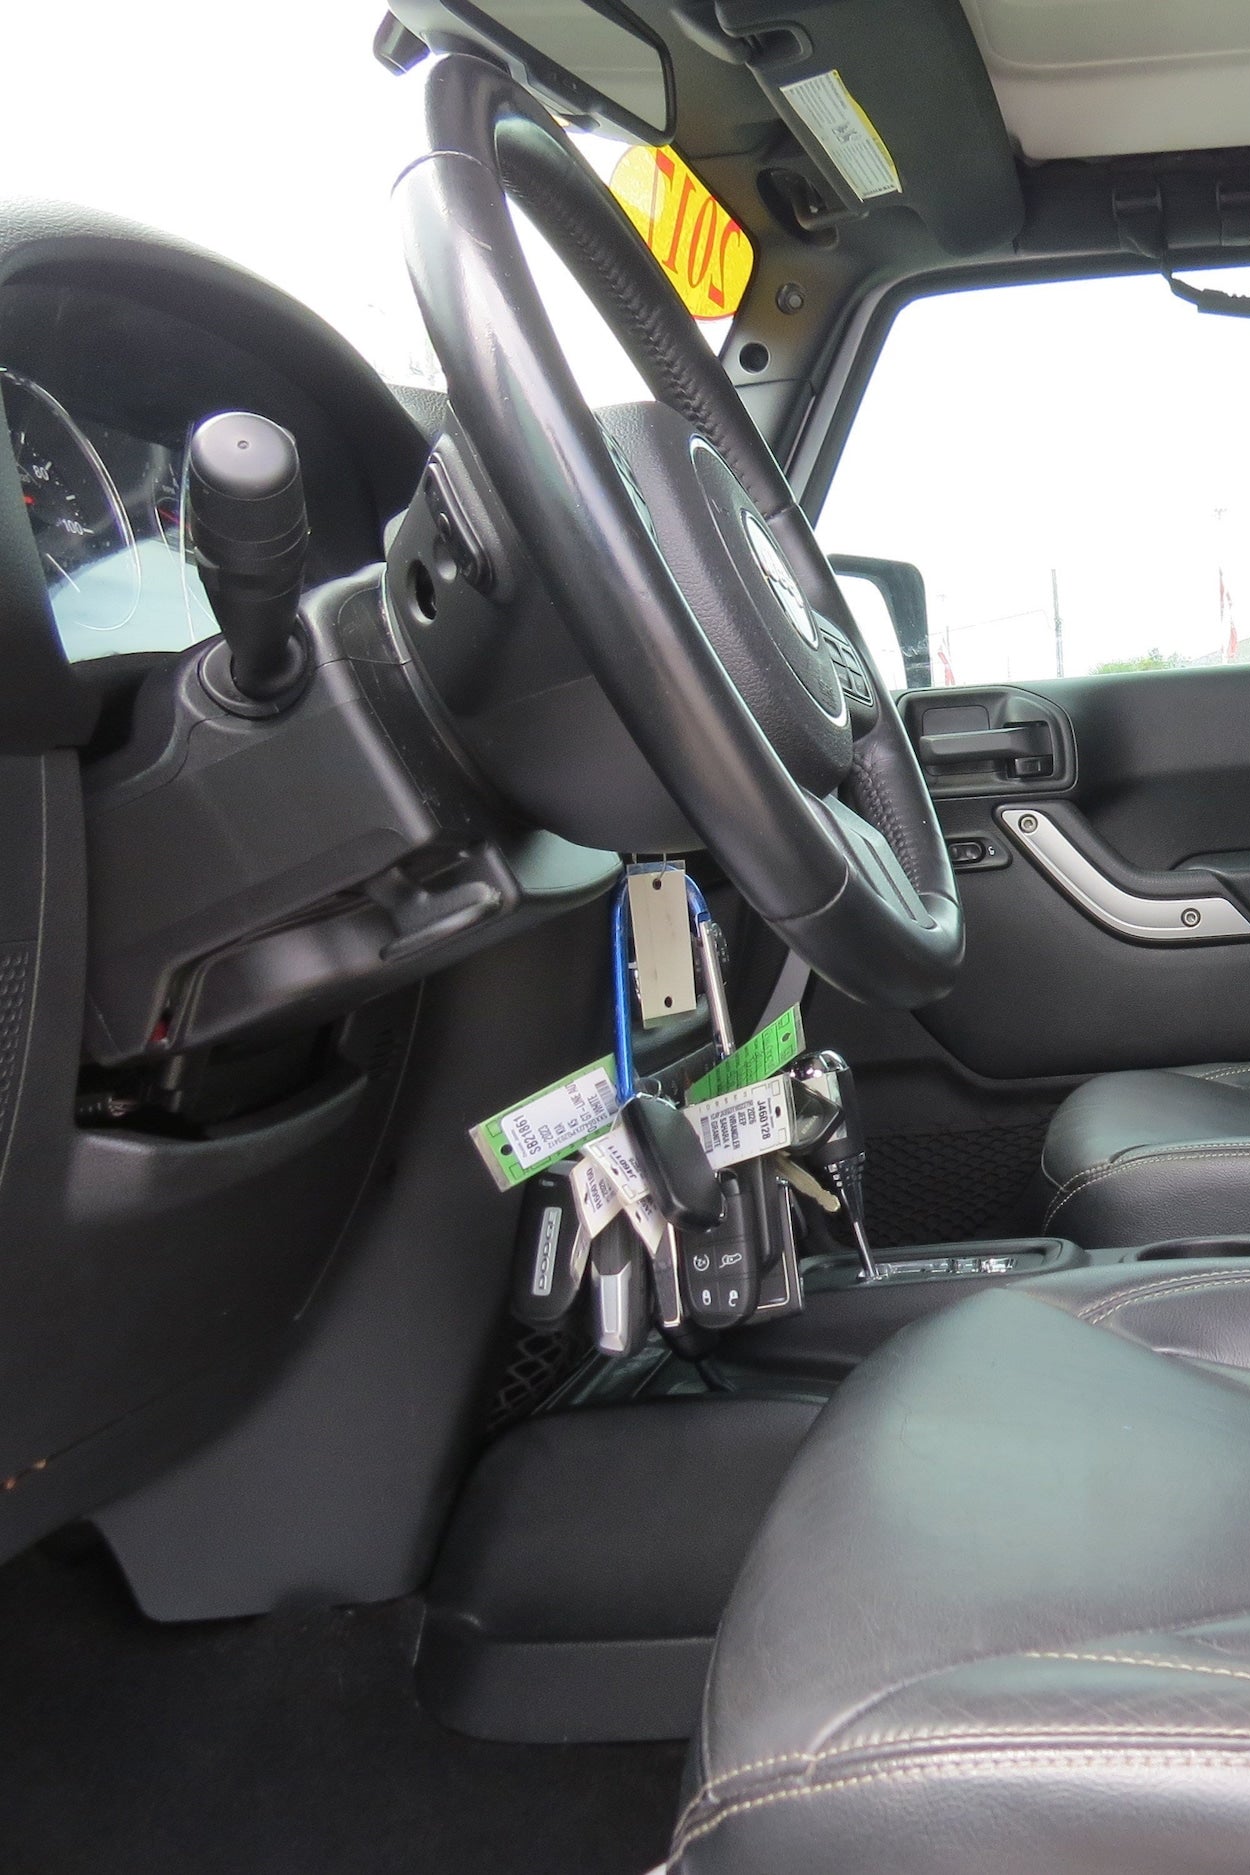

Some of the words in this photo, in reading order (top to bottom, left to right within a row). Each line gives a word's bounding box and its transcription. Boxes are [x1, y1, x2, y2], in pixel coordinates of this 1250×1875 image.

[32, 463, 50, 481] 80
[61, 519, 83, 535] 100
[587, 1093, 605, 1115] WHITE
[553, 1122, 566, 1136] KIA
[567, 1118, 579, 1128] K5
[720, 1117, 729, 1143] SAHARA
[738, 1111, 746, 1126] JEEP
[757, 1100, 771, 1140] J460128
[512, 1113, 542, 1156] SB21861
[538, 1124, 554, 1143] 2023
[712, 1120, 721, 1148] GRANITE
[729, 1114, 740, 1150] WRANGLER
[607, 1145, 637, 1180] J460111
[585, 1167, 603, 1210] R660160
[538, 1210, 557, 1290] DODGE
